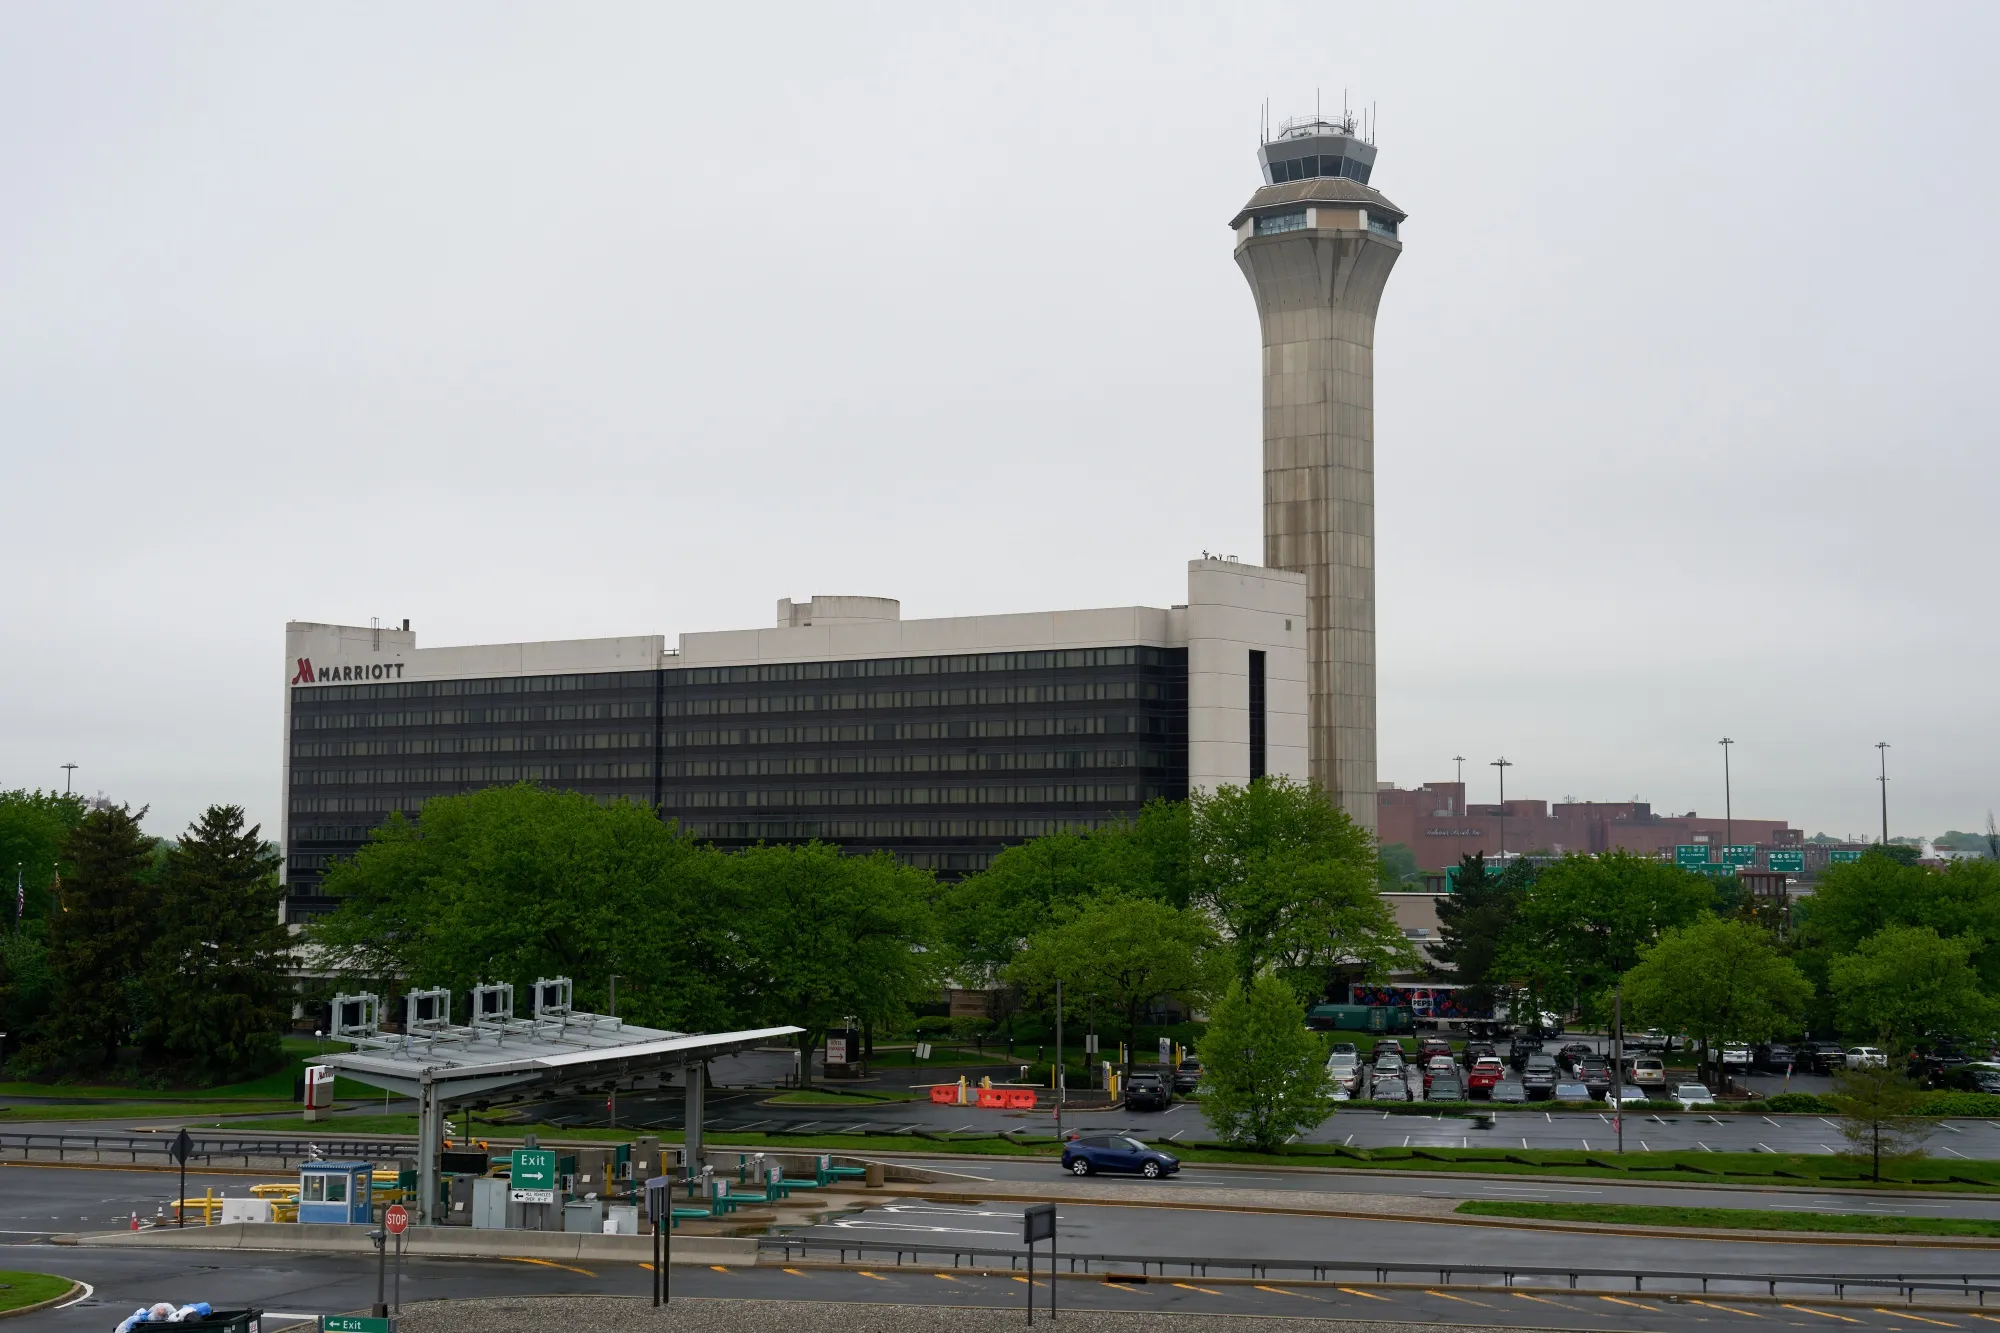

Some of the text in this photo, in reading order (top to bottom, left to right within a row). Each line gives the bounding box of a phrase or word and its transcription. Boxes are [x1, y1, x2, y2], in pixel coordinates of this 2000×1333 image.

[318, 663, 405, 682] MARRIOTT
[1412, 999, 1433, 1007] PEPSI
[521, 1154, 546, 1166] Exit
[387, 1213, 407, 1226] STOP
[343, 1320, 361, 1330] Exit
